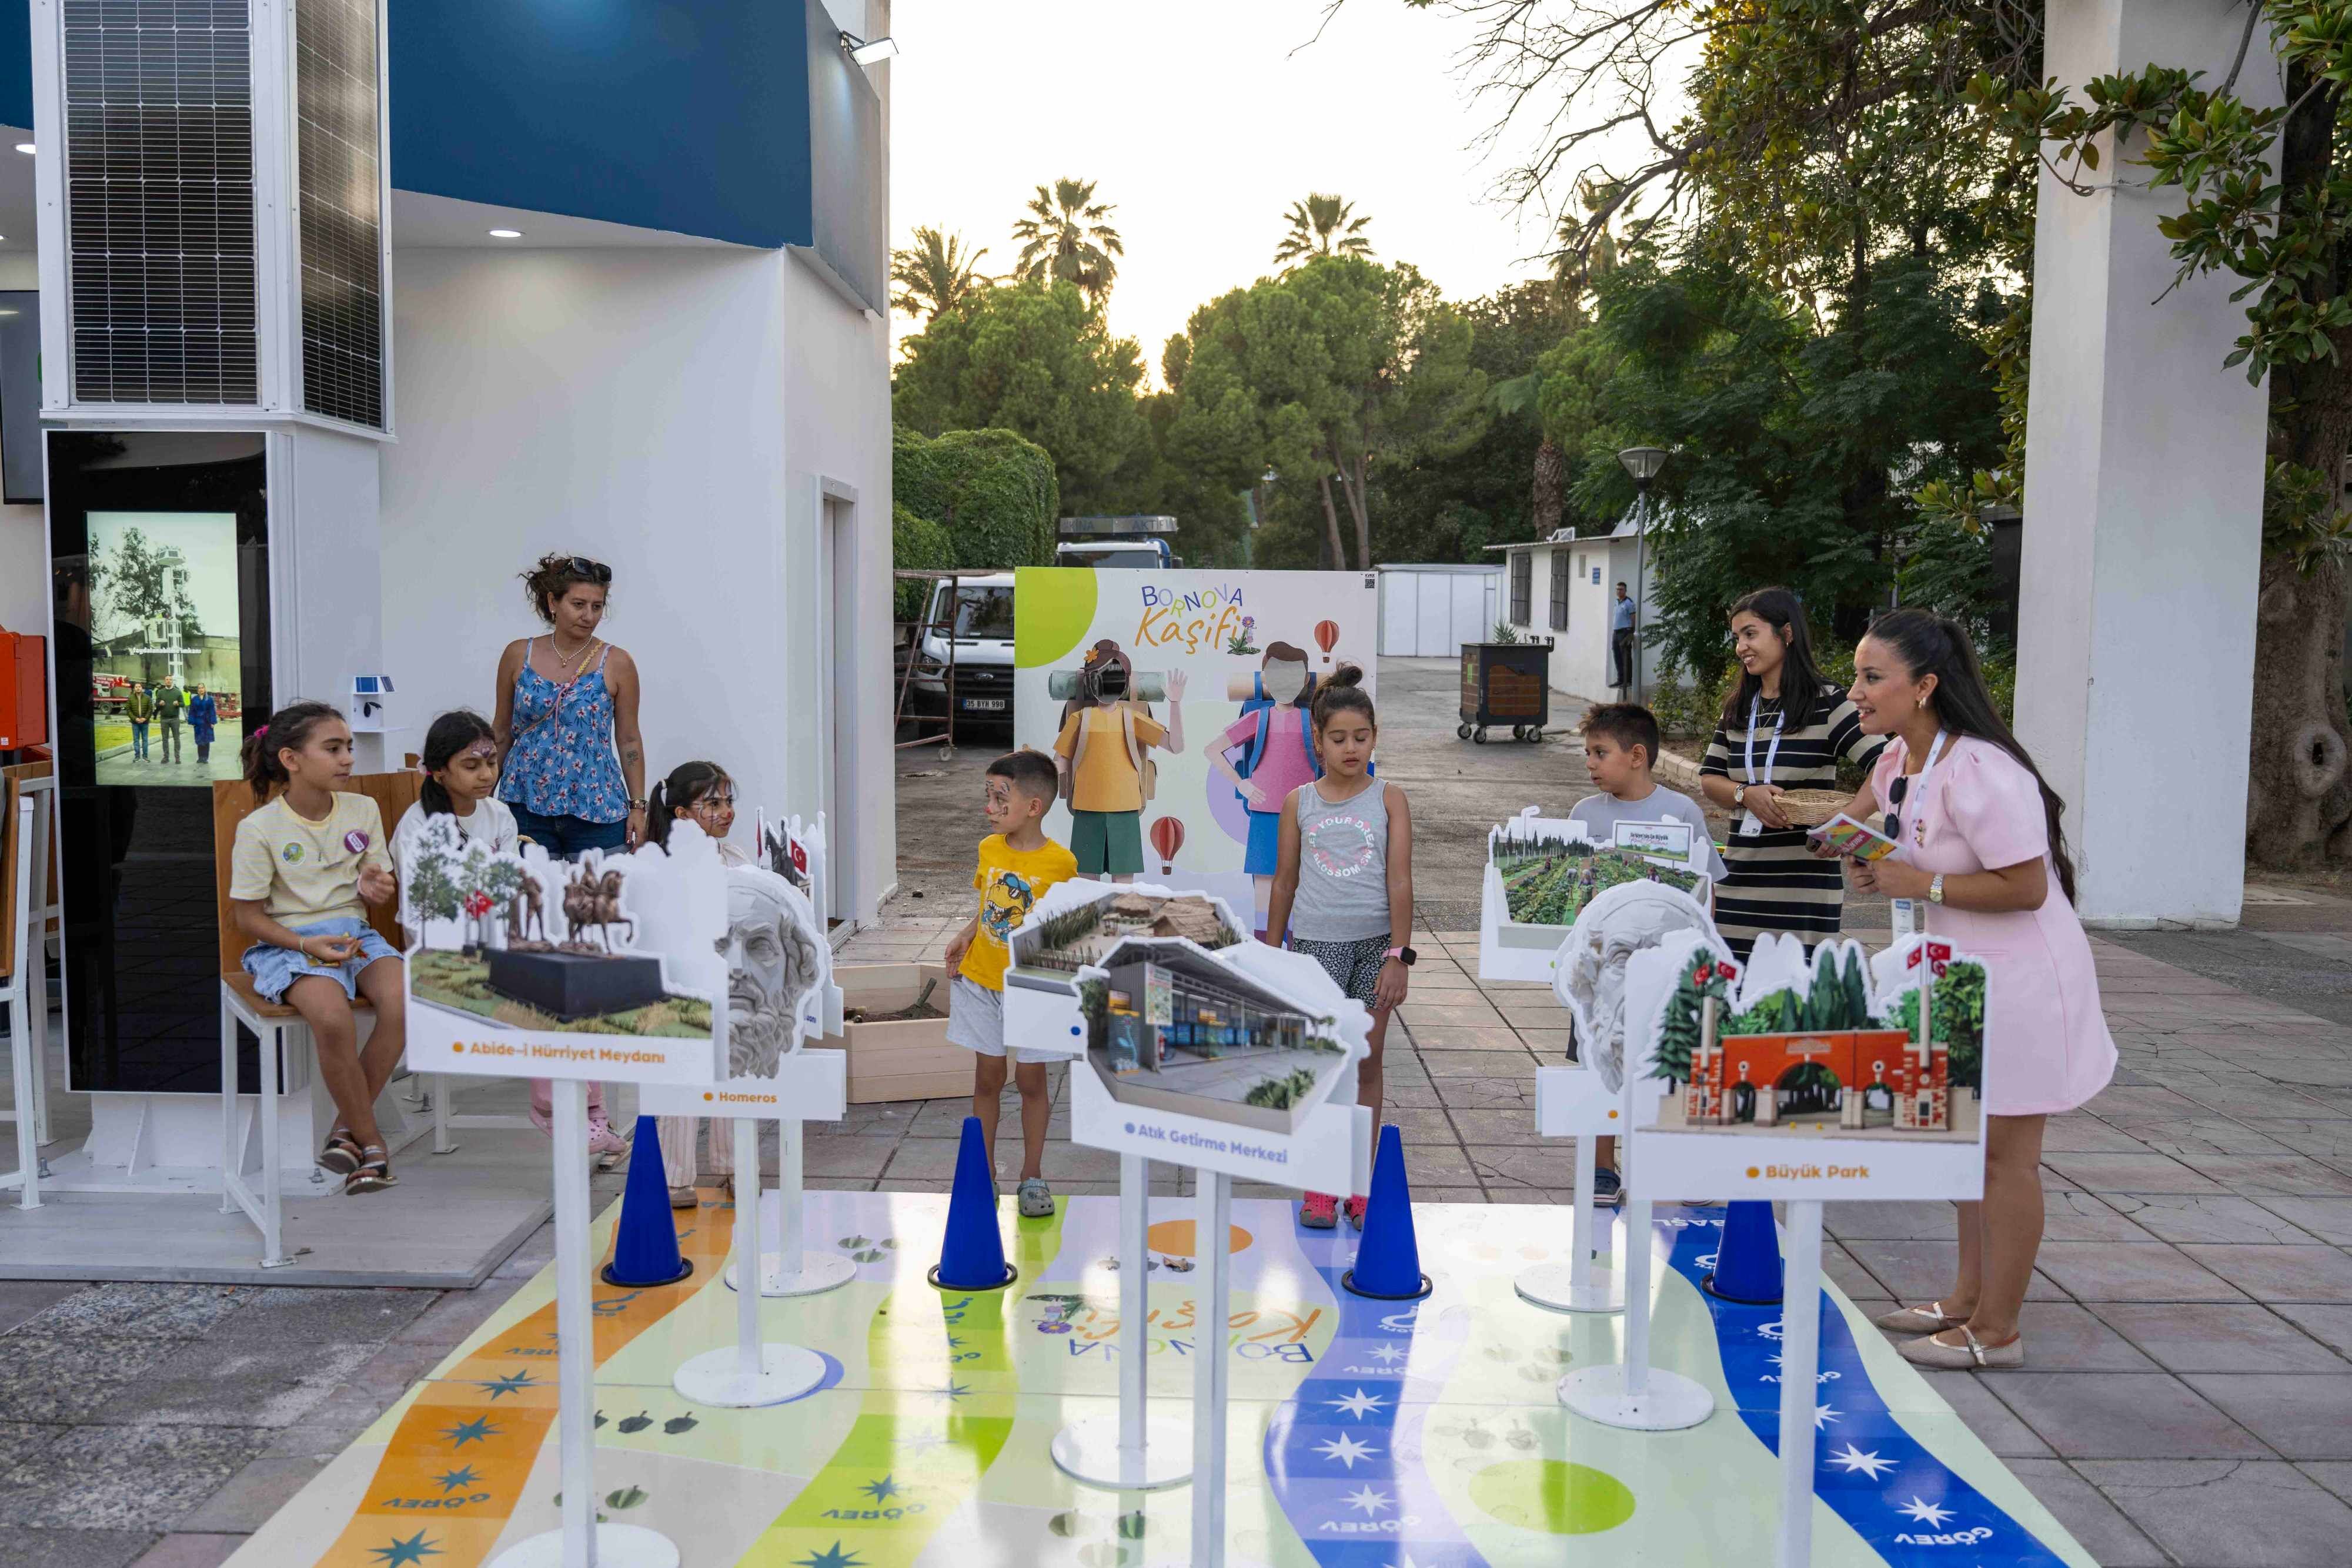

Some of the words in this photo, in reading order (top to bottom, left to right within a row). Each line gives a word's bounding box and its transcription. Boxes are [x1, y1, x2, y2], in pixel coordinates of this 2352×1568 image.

[1141, 583, 1242, 618] BORNOVA
[1135, 606, 1241, 654] Kaşifi
[1318, 817, 1352, 829] YOUR
[1313, 853, 1361, 877] BLOSSOM
[532, 1044, 594, 1061] Hürriyet
[600, 1048, 665, 1063] Meydanı
[720, 1091, 777, 1103] Homeros
[1138, 1124, 1165, 1140] Atık
[1170, 1129, 1227, 1152] Getirme
[1230, 1141, 1288, 1164] Merkezi
[1766, 1163, 1821, 1181] Büyük
[1828, 1164, 1870, 1179] Park
[1652, 1217, 1725, 1226] BAŞL
[1894, 1526, 1993, 1546] GÖREV
